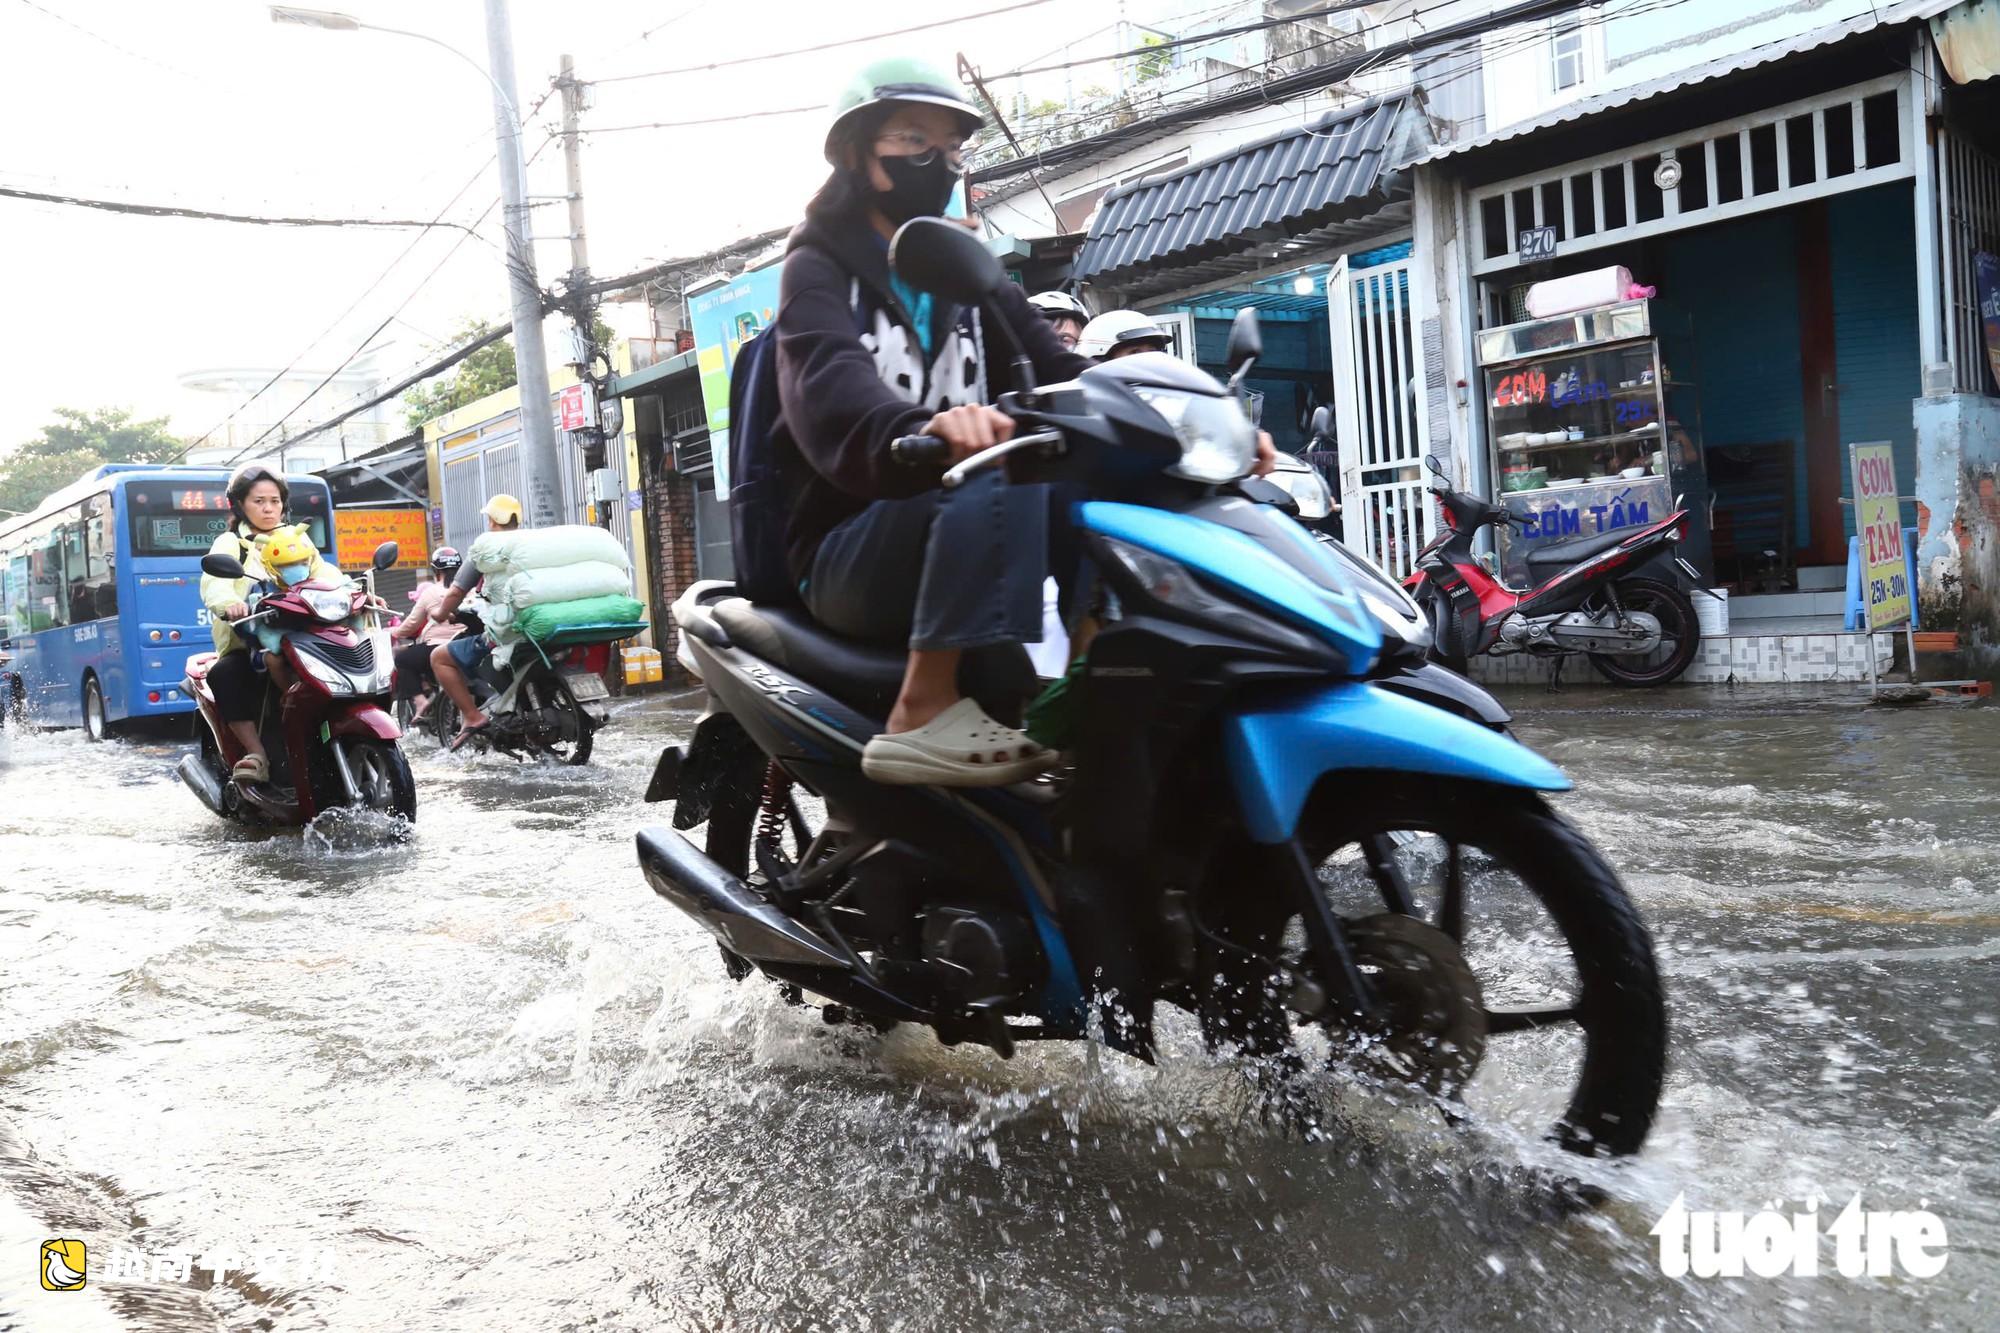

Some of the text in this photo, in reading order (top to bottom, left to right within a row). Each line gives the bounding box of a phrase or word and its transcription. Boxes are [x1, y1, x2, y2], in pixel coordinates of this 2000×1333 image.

[1522, 229, 1555, 257] 270
[1496, 369, 1546, 407] CƠM
[1858, 451, 1893, 496] CƠM
[181, 491, 205, 510] 44
[1523, 487, 1649, 539] CƠM TẤM
[1865, 506, 1902, 564] TẤM
